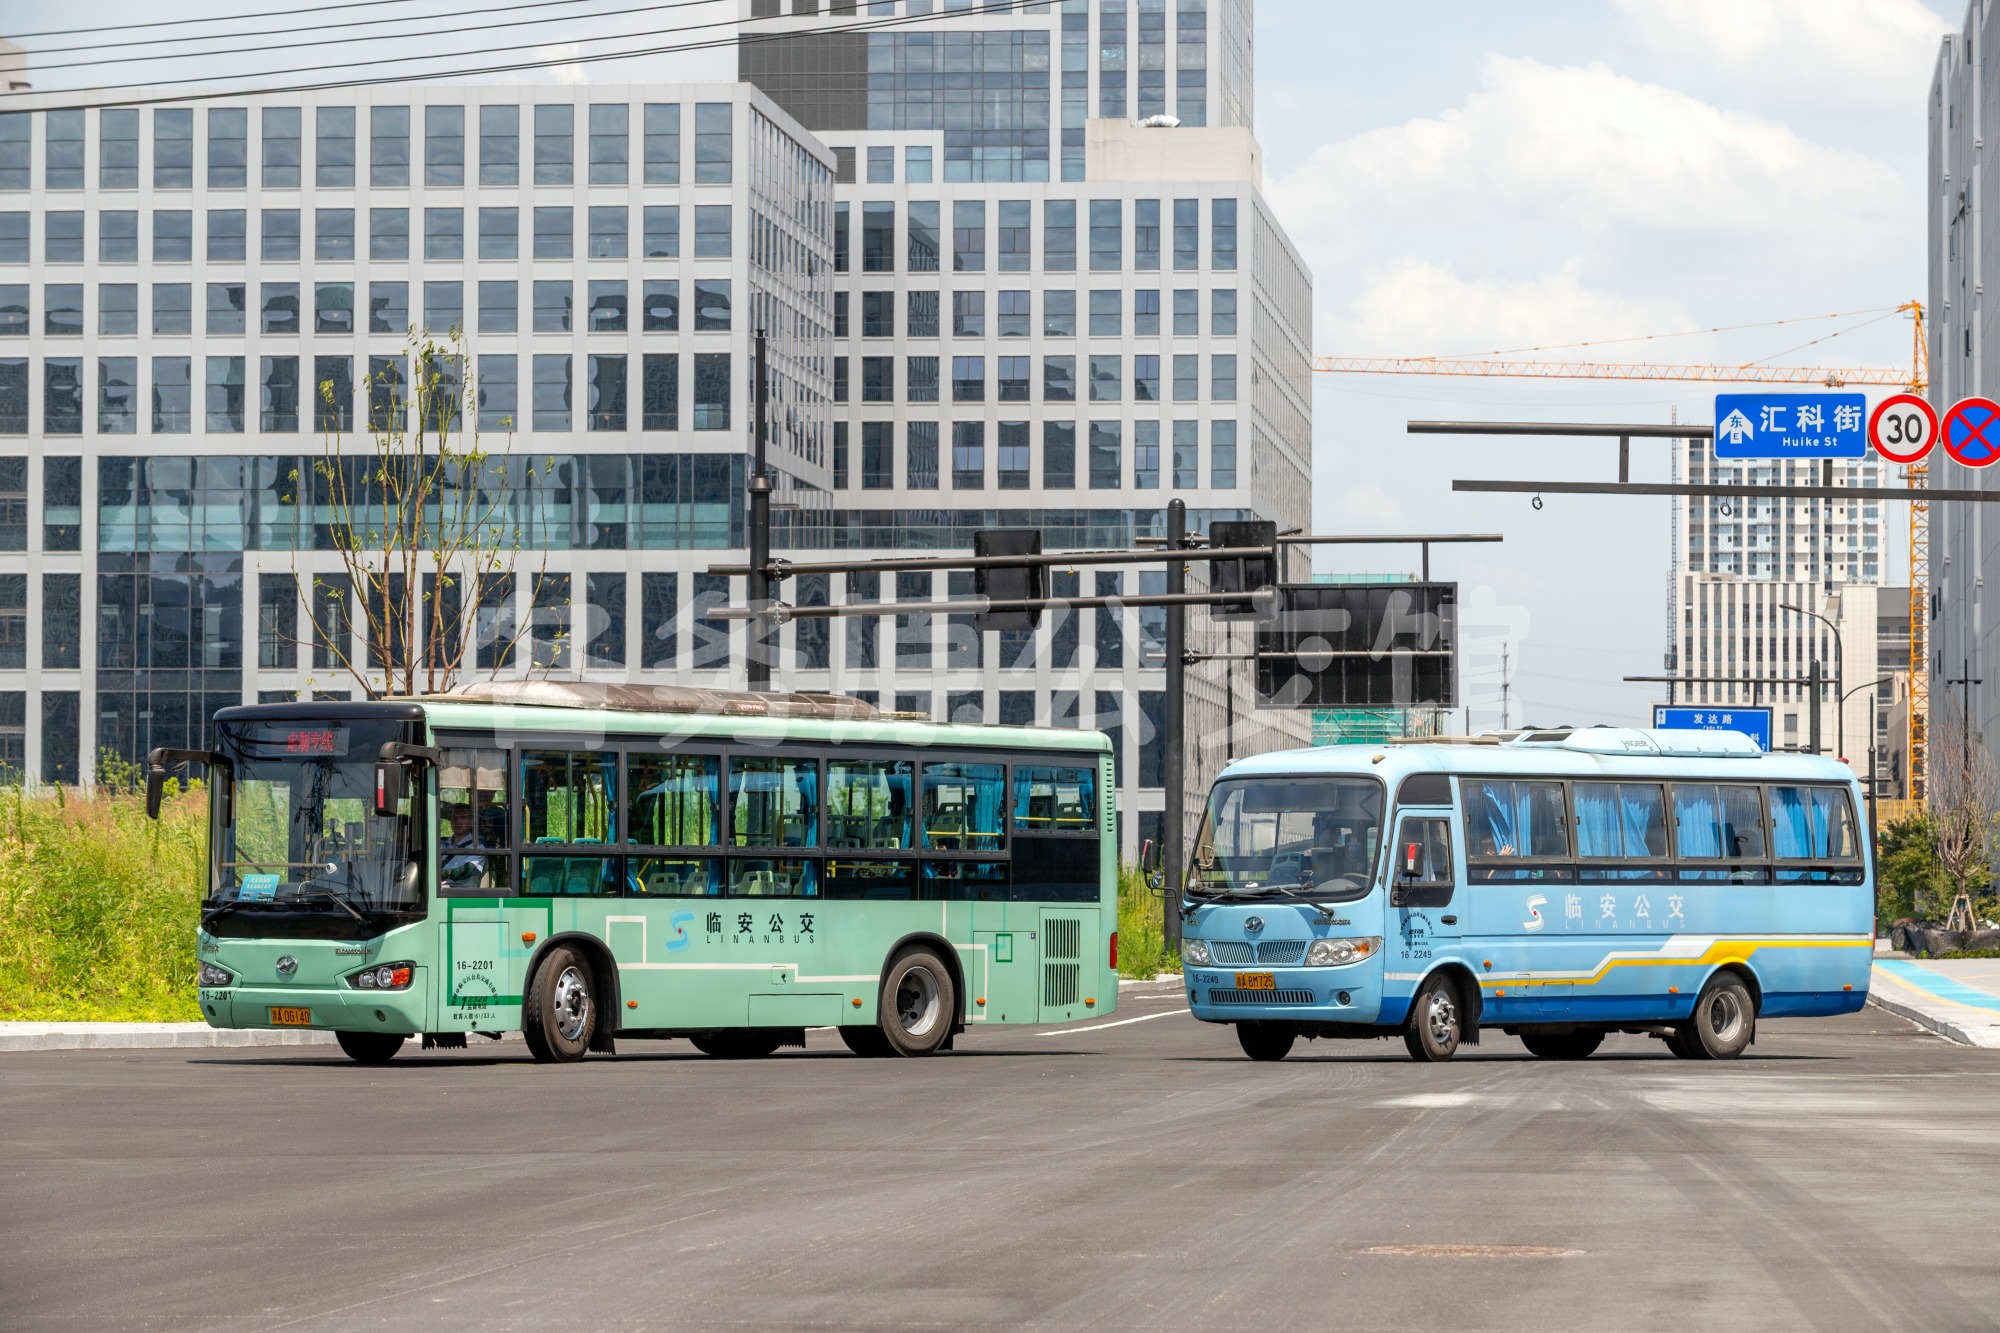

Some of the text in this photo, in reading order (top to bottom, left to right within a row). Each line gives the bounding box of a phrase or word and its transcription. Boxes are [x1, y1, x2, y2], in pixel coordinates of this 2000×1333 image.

[1730, 415, 1743, 428] 东
[1760, 404, 1862, 433] 汇科街
[1886, 414, 1923, 444] 30
[1782, 437, 1838, 447] Huike St
[1693, 713, 1733, 725] 发达路
[286, 731, 333, 753] 定制专线
[1565, 893, 1685, 919] 临安公交
[706, 912, 815, 934] 临安公交
[456, 960, 493, 970] 16-2201
[1192, 974, 1219, 984] 16-2249
[201, 990, 232, 1001] 16-2201
